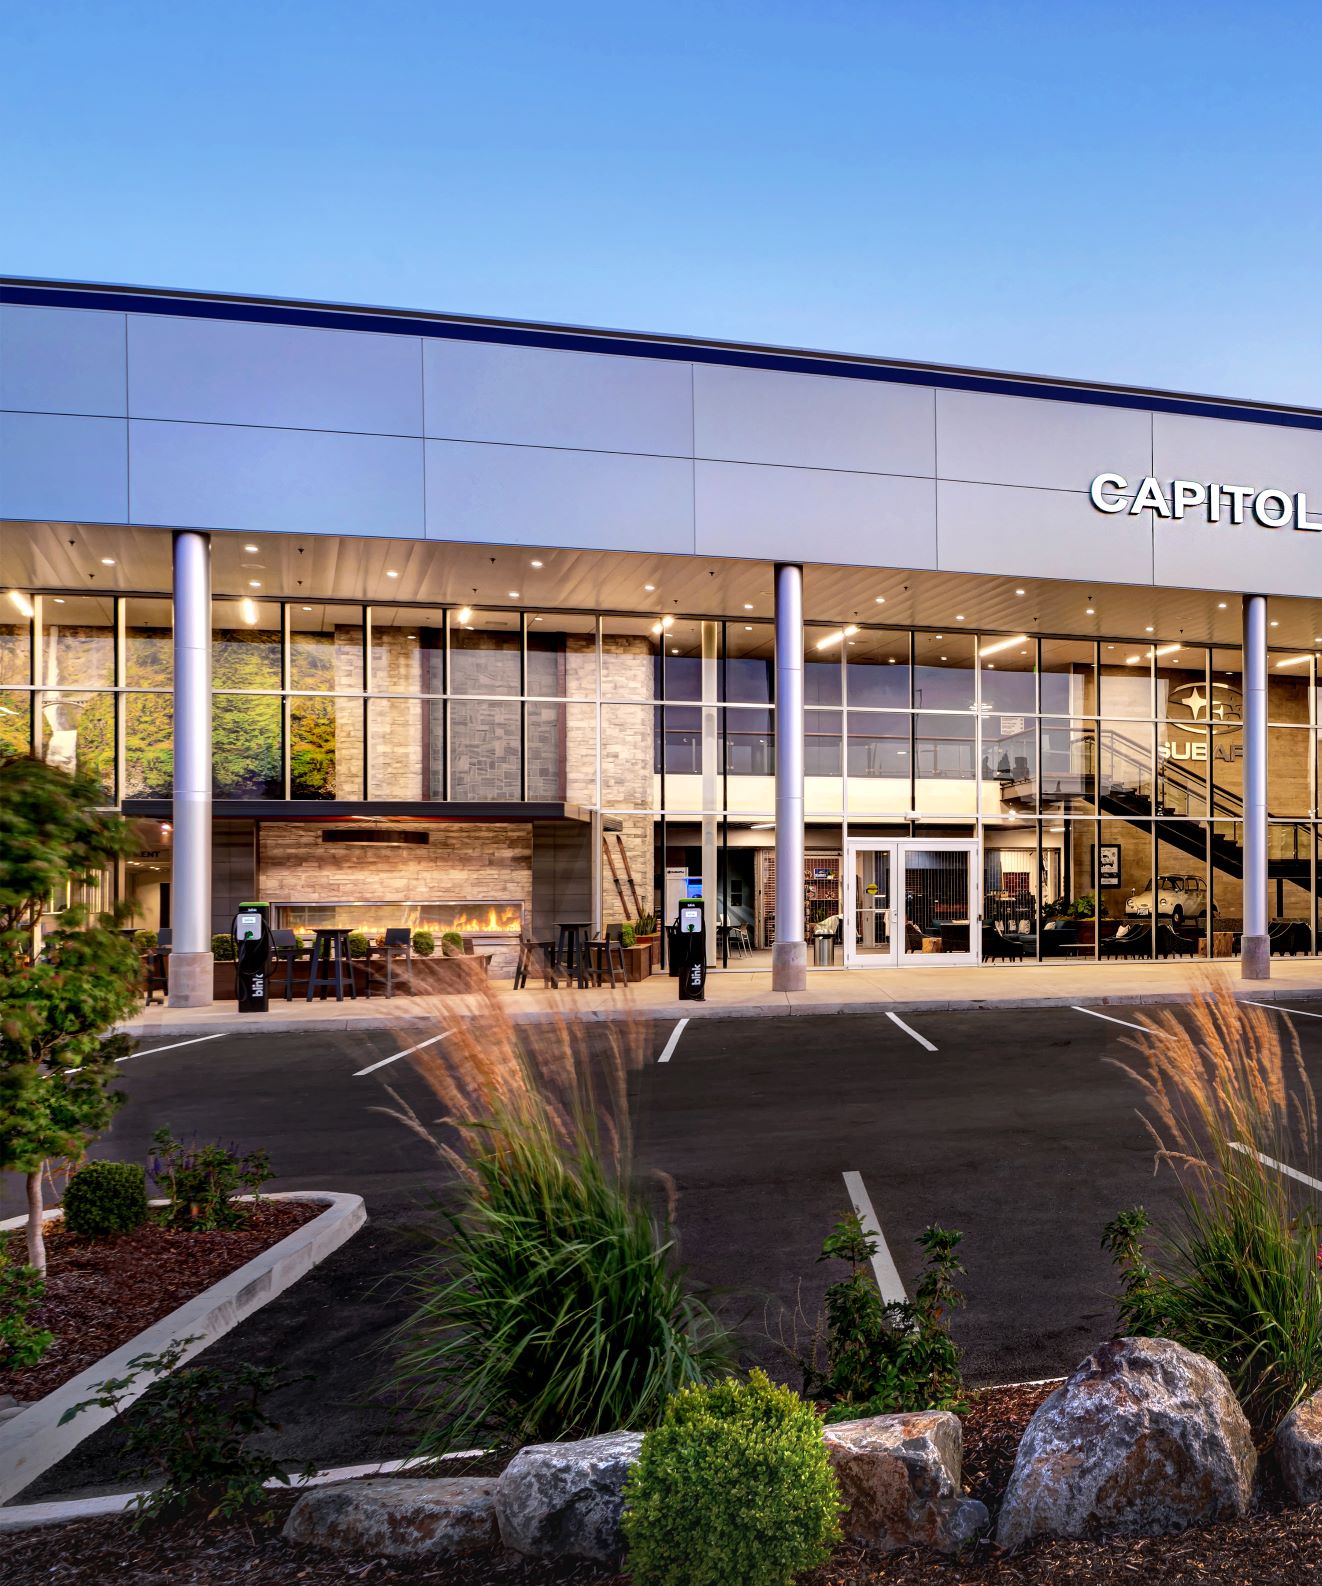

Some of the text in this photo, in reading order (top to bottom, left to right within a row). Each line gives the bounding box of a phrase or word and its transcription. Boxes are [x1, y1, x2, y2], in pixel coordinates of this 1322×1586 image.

[1157, 741, 1243, 762] SUBAR
[252, 973, 265, 998] blink
[692, 963, 702, 986] blink
